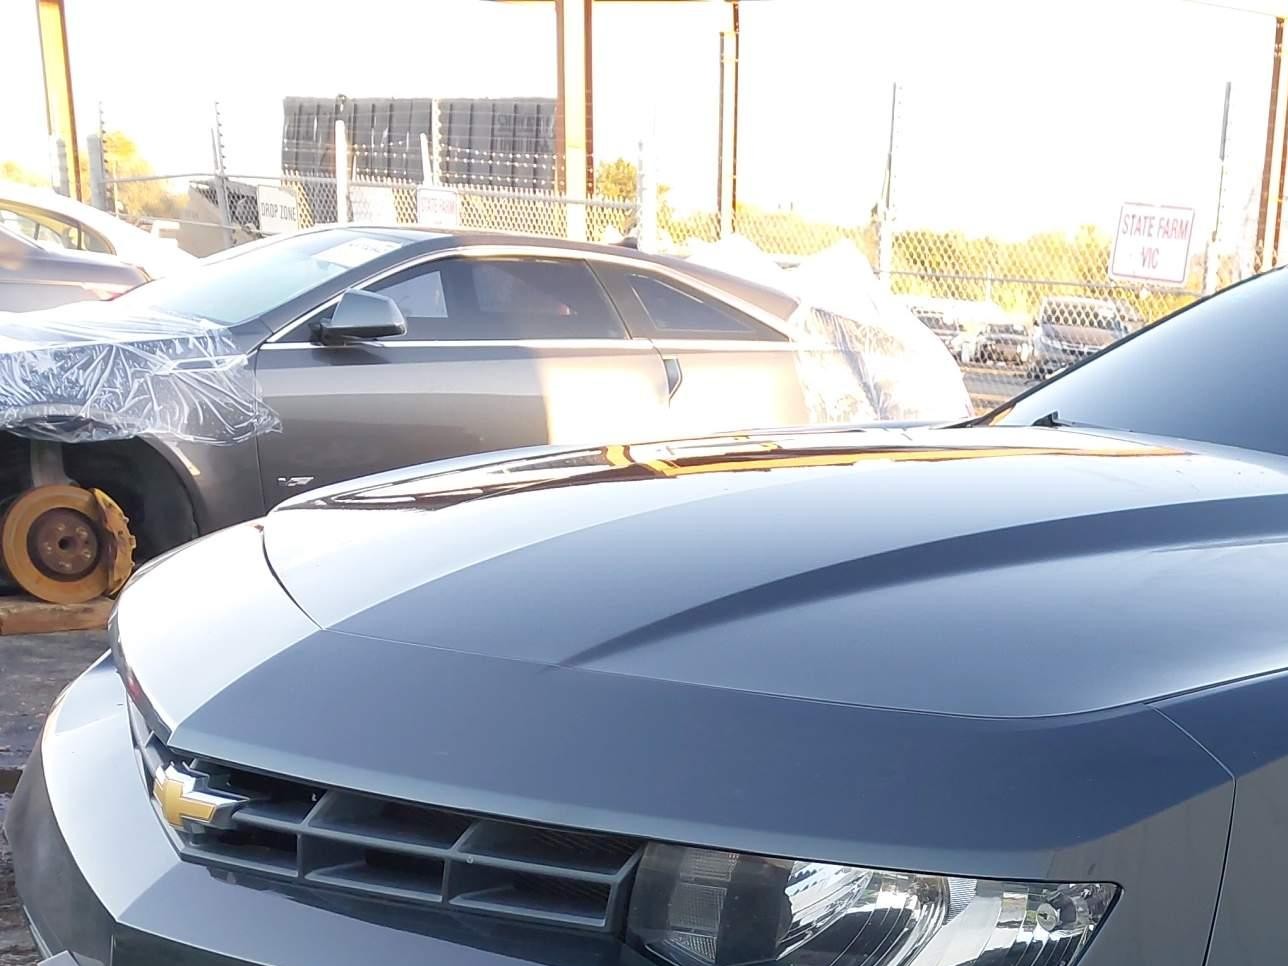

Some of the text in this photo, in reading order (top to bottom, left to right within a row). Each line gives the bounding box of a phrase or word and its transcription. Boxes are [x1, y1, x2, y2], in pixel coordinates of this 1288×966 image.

[260, 202, 278, 218] DROP
[1122, 214, 1189, 241] STATE FARM
[1141, 246, 1160, 270] VIC
